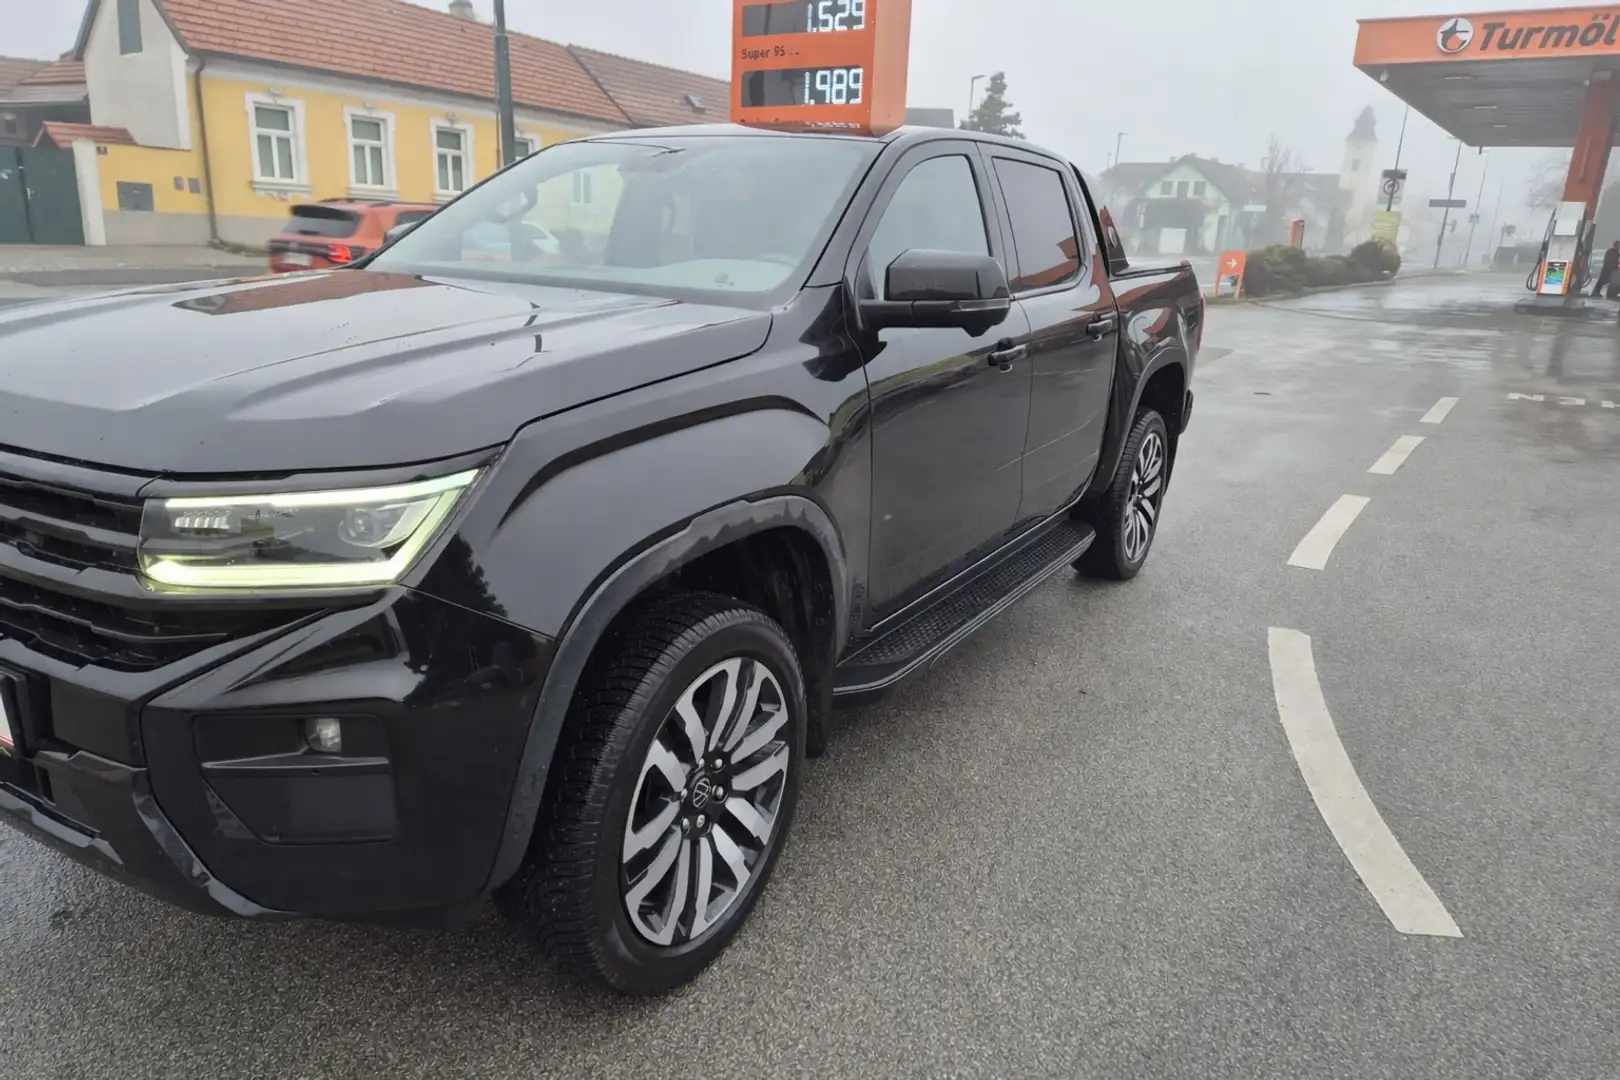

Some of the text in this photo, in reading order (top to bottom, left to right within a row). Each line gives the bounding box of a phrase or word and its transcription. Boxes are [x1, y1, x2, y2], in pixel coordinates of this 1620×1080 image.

[807, 0, 865, 32] 1.529
[1479, 13, 1620, 51] Turmöl
[741, 45, 785, 60] Super 95
[804, 68, 863, 105] 1.989
